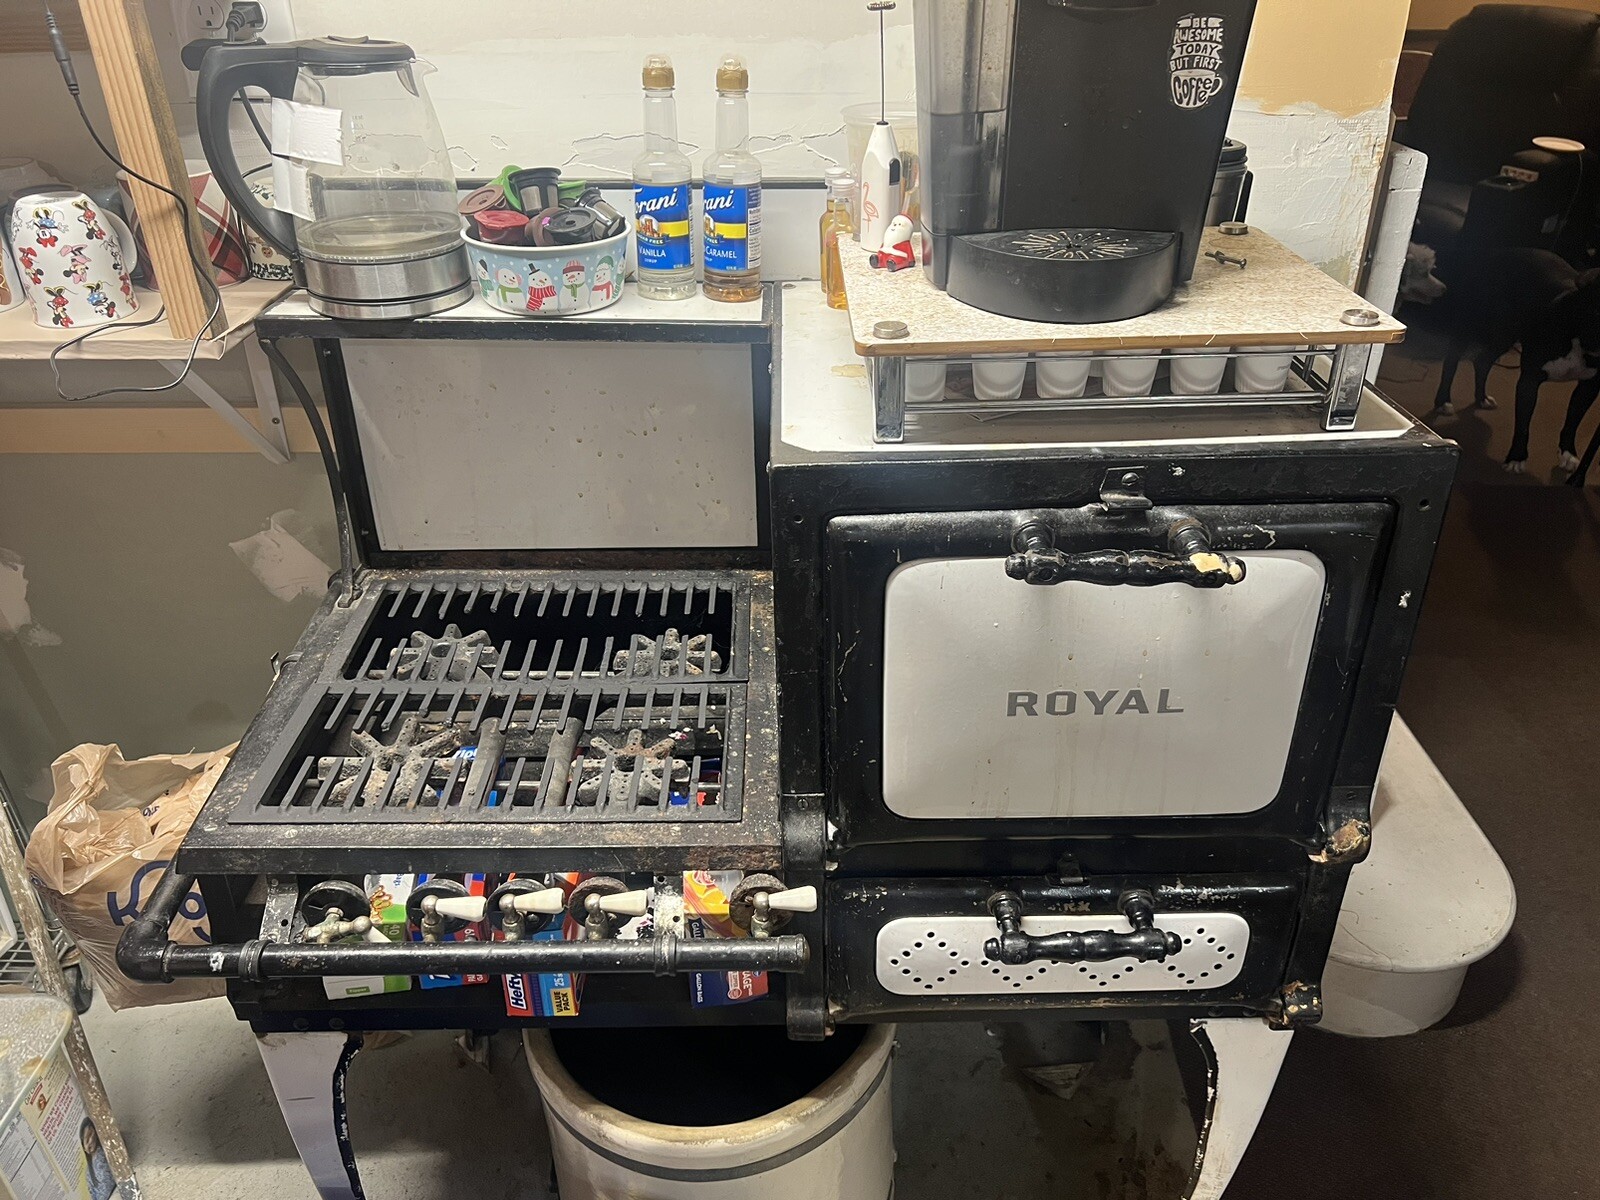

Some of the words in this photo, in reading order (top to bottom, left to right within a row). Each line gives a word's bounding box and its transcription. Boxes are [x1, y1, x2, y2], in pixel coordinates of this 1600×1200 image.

[1192, 17, 1207, 28] BE
[1173, 27, 1224, 44] AWESOME
[1176, 43, 1218, 55] TODAY
[1169, 57, 1189, 71] BUT
[1193, 56, 1223, 70] FIRST
[1173, 75, 1213, 106] Coffee
[634, 187, 678, 213] rani
[702, 186, 735, 211] ani
[638, 245, 667, 258] VANILLA
[705, 246, 737, 259] CARAMEL
[1006, 687, 1185, 717] ROYAL
[691, 922, 703, 939] GALL
[553, 991, 563, 1013] VALUE
[561, 992, 571, 1012] PACK
